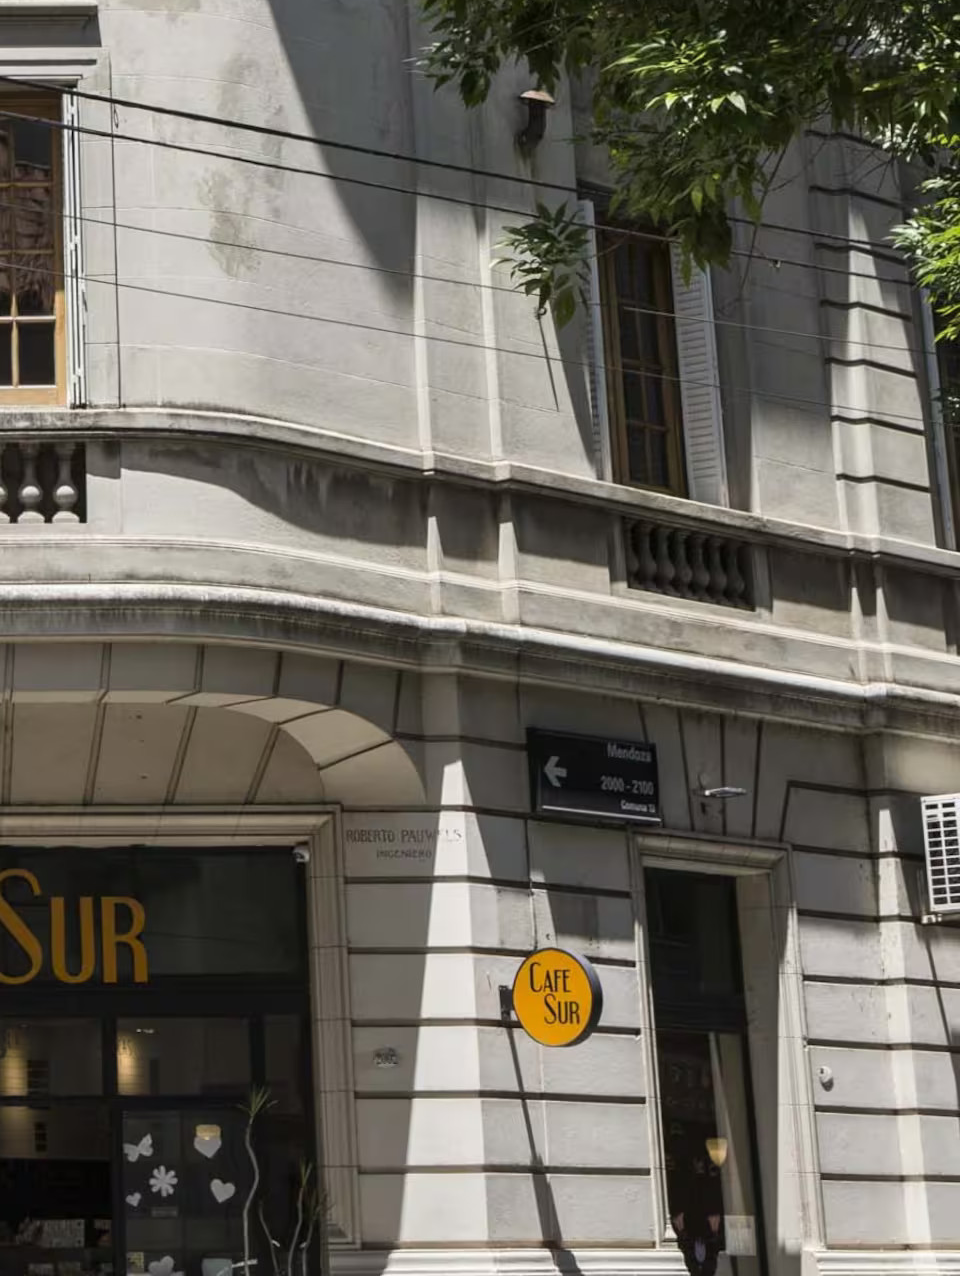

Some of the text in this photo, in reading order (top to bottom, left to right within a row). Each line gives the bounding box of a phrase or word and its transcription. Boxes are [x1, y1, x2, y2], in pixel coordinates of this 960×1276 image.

[607, 741, 652, 763] Mendoza
[346, 829, 395, 843] ROBERTO
[376, 849, 432, 859] INGENIERO
[529, 962, 572, 993] CAFE
[544, 993, 580, 1025] SUR
